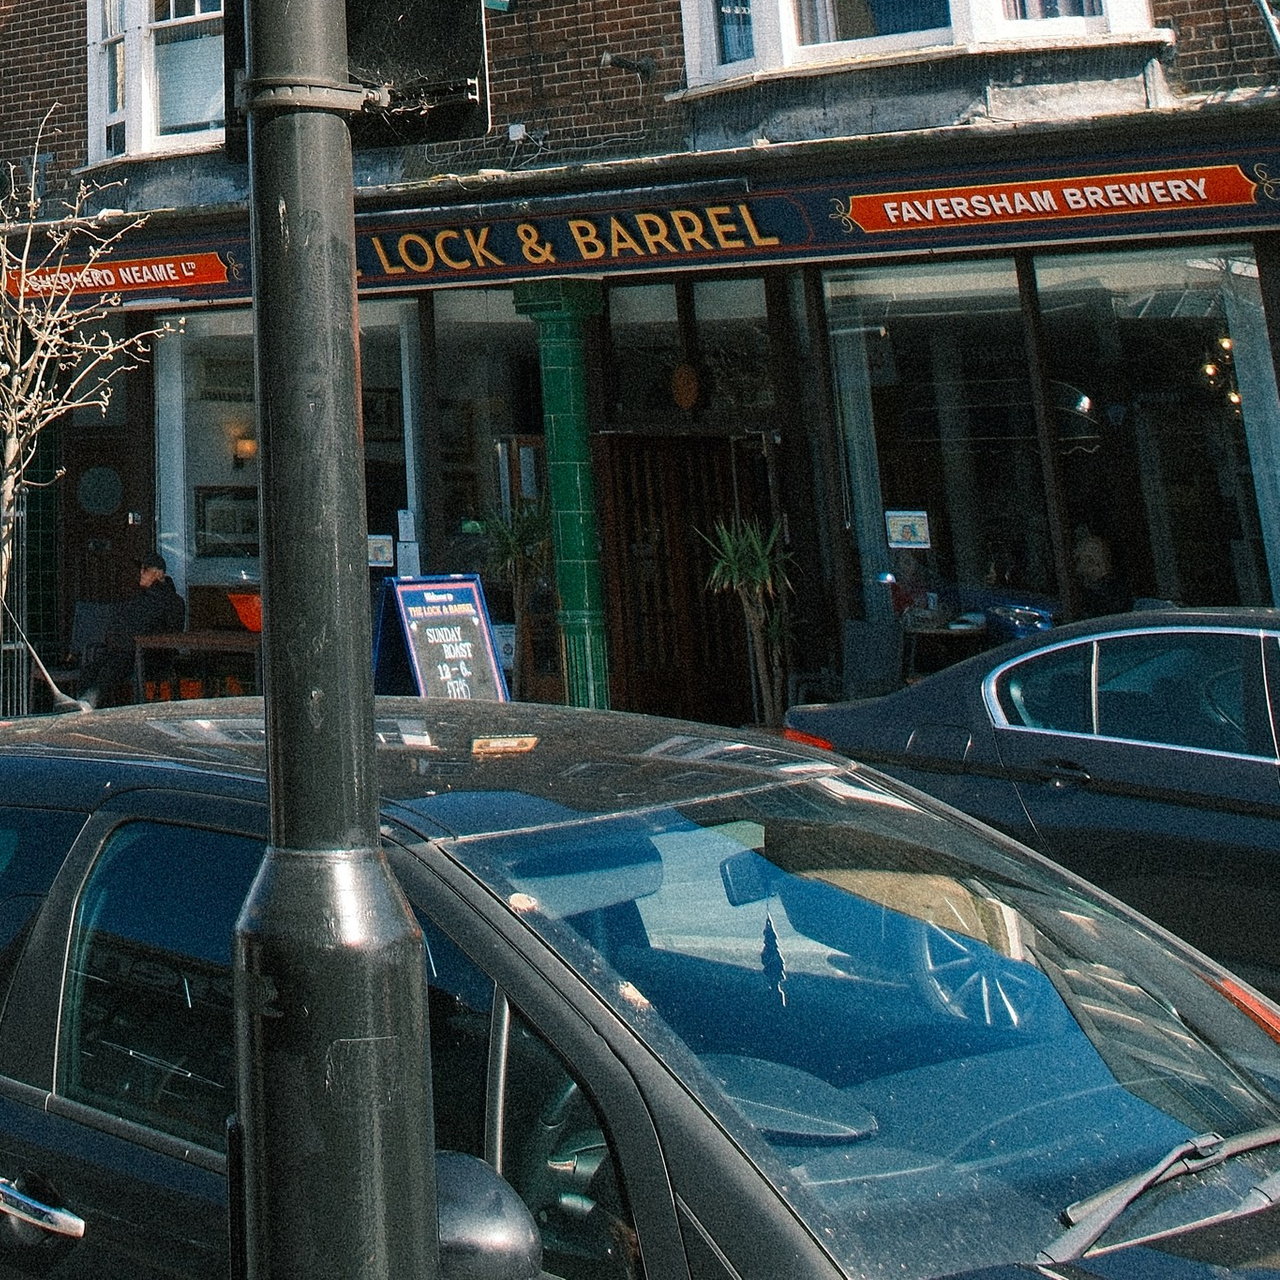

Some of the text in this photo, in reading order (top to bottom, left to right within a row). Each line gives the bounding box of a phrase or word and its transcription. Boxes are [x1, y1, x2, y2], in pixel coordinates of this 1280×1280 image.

[883, 178, 1210, 224] FAVERSHAM BREWERY
[372, 204, 780, 275] LOCK & BARREL
[28, 269, 116, 292] SHEPHERD
[119, 263, 180, 285] NEAME
[408, 606, 423, 617] THE
[423, 605, 441, 616] LOCK
[448, 603, 477, 615] BARREL
[426, 626, 463, 644] SUNDAY
[442, 642, 473, 659] ROAST
